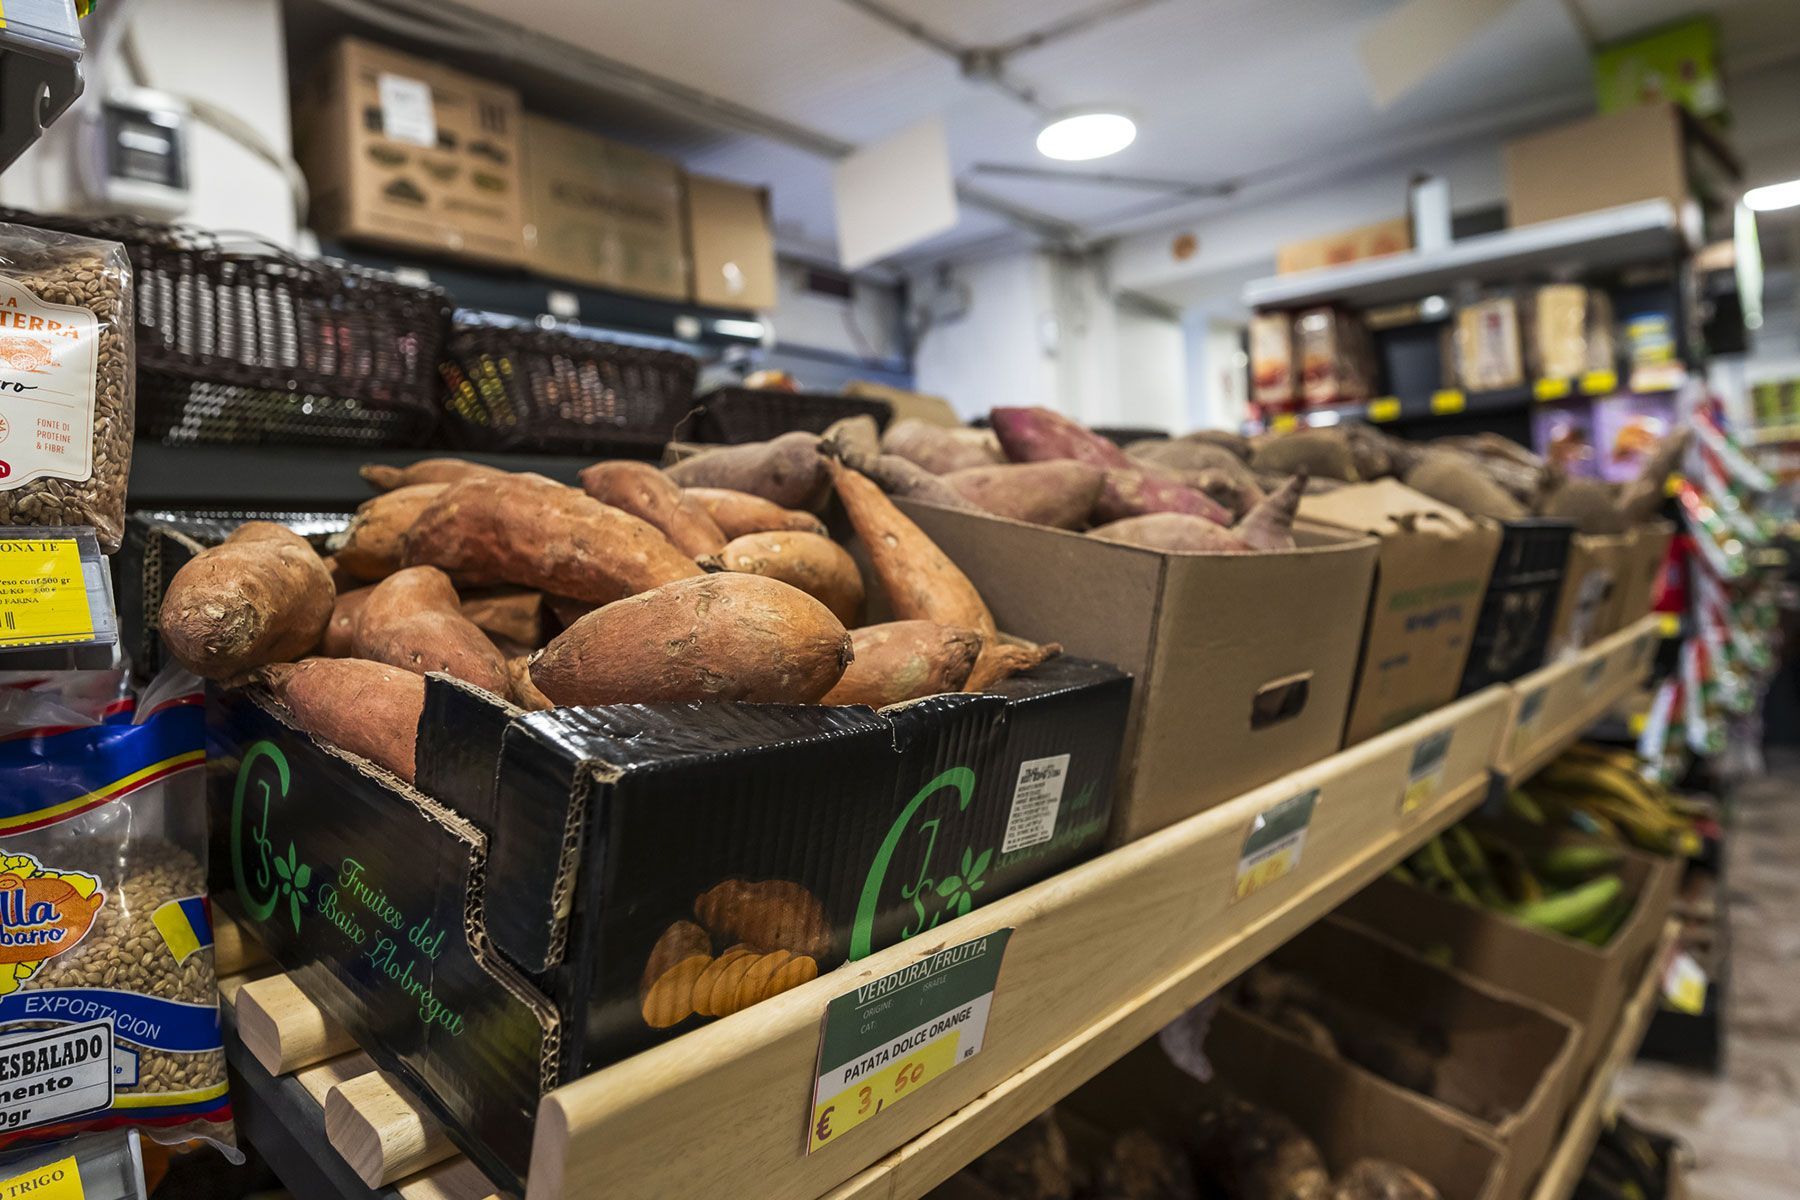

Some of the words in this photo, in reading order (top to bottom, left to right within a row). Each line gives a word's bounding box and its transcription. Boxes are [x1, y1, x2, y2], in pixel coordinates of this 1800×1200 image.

[36, 430, 71, 443] PROTEINE
[37, 418, 59, 430] FONTE
[62, 423, 70, 431] DI
[44, 443, 64, 454] FIBRE
[339, 858, 404, 930] Fruites
[408, 918, 446, 960] del
[318, 884, 367, 944] Baix
[365, 930, 464, 1037] Llobregat
[855, 938, 987, 1005] VERDURA/FRUTTA
[25, 996, 161, 1040] EXPORTACION
[844, 1049, 889, 1084] PATATA
[892, 1029, 927, 1058] DOLCE
[929, 1006, 973, 1038] ORANGE
[816, 1105, 835, 1141] €
[7, 1169, 65, 1197] TRIGO
